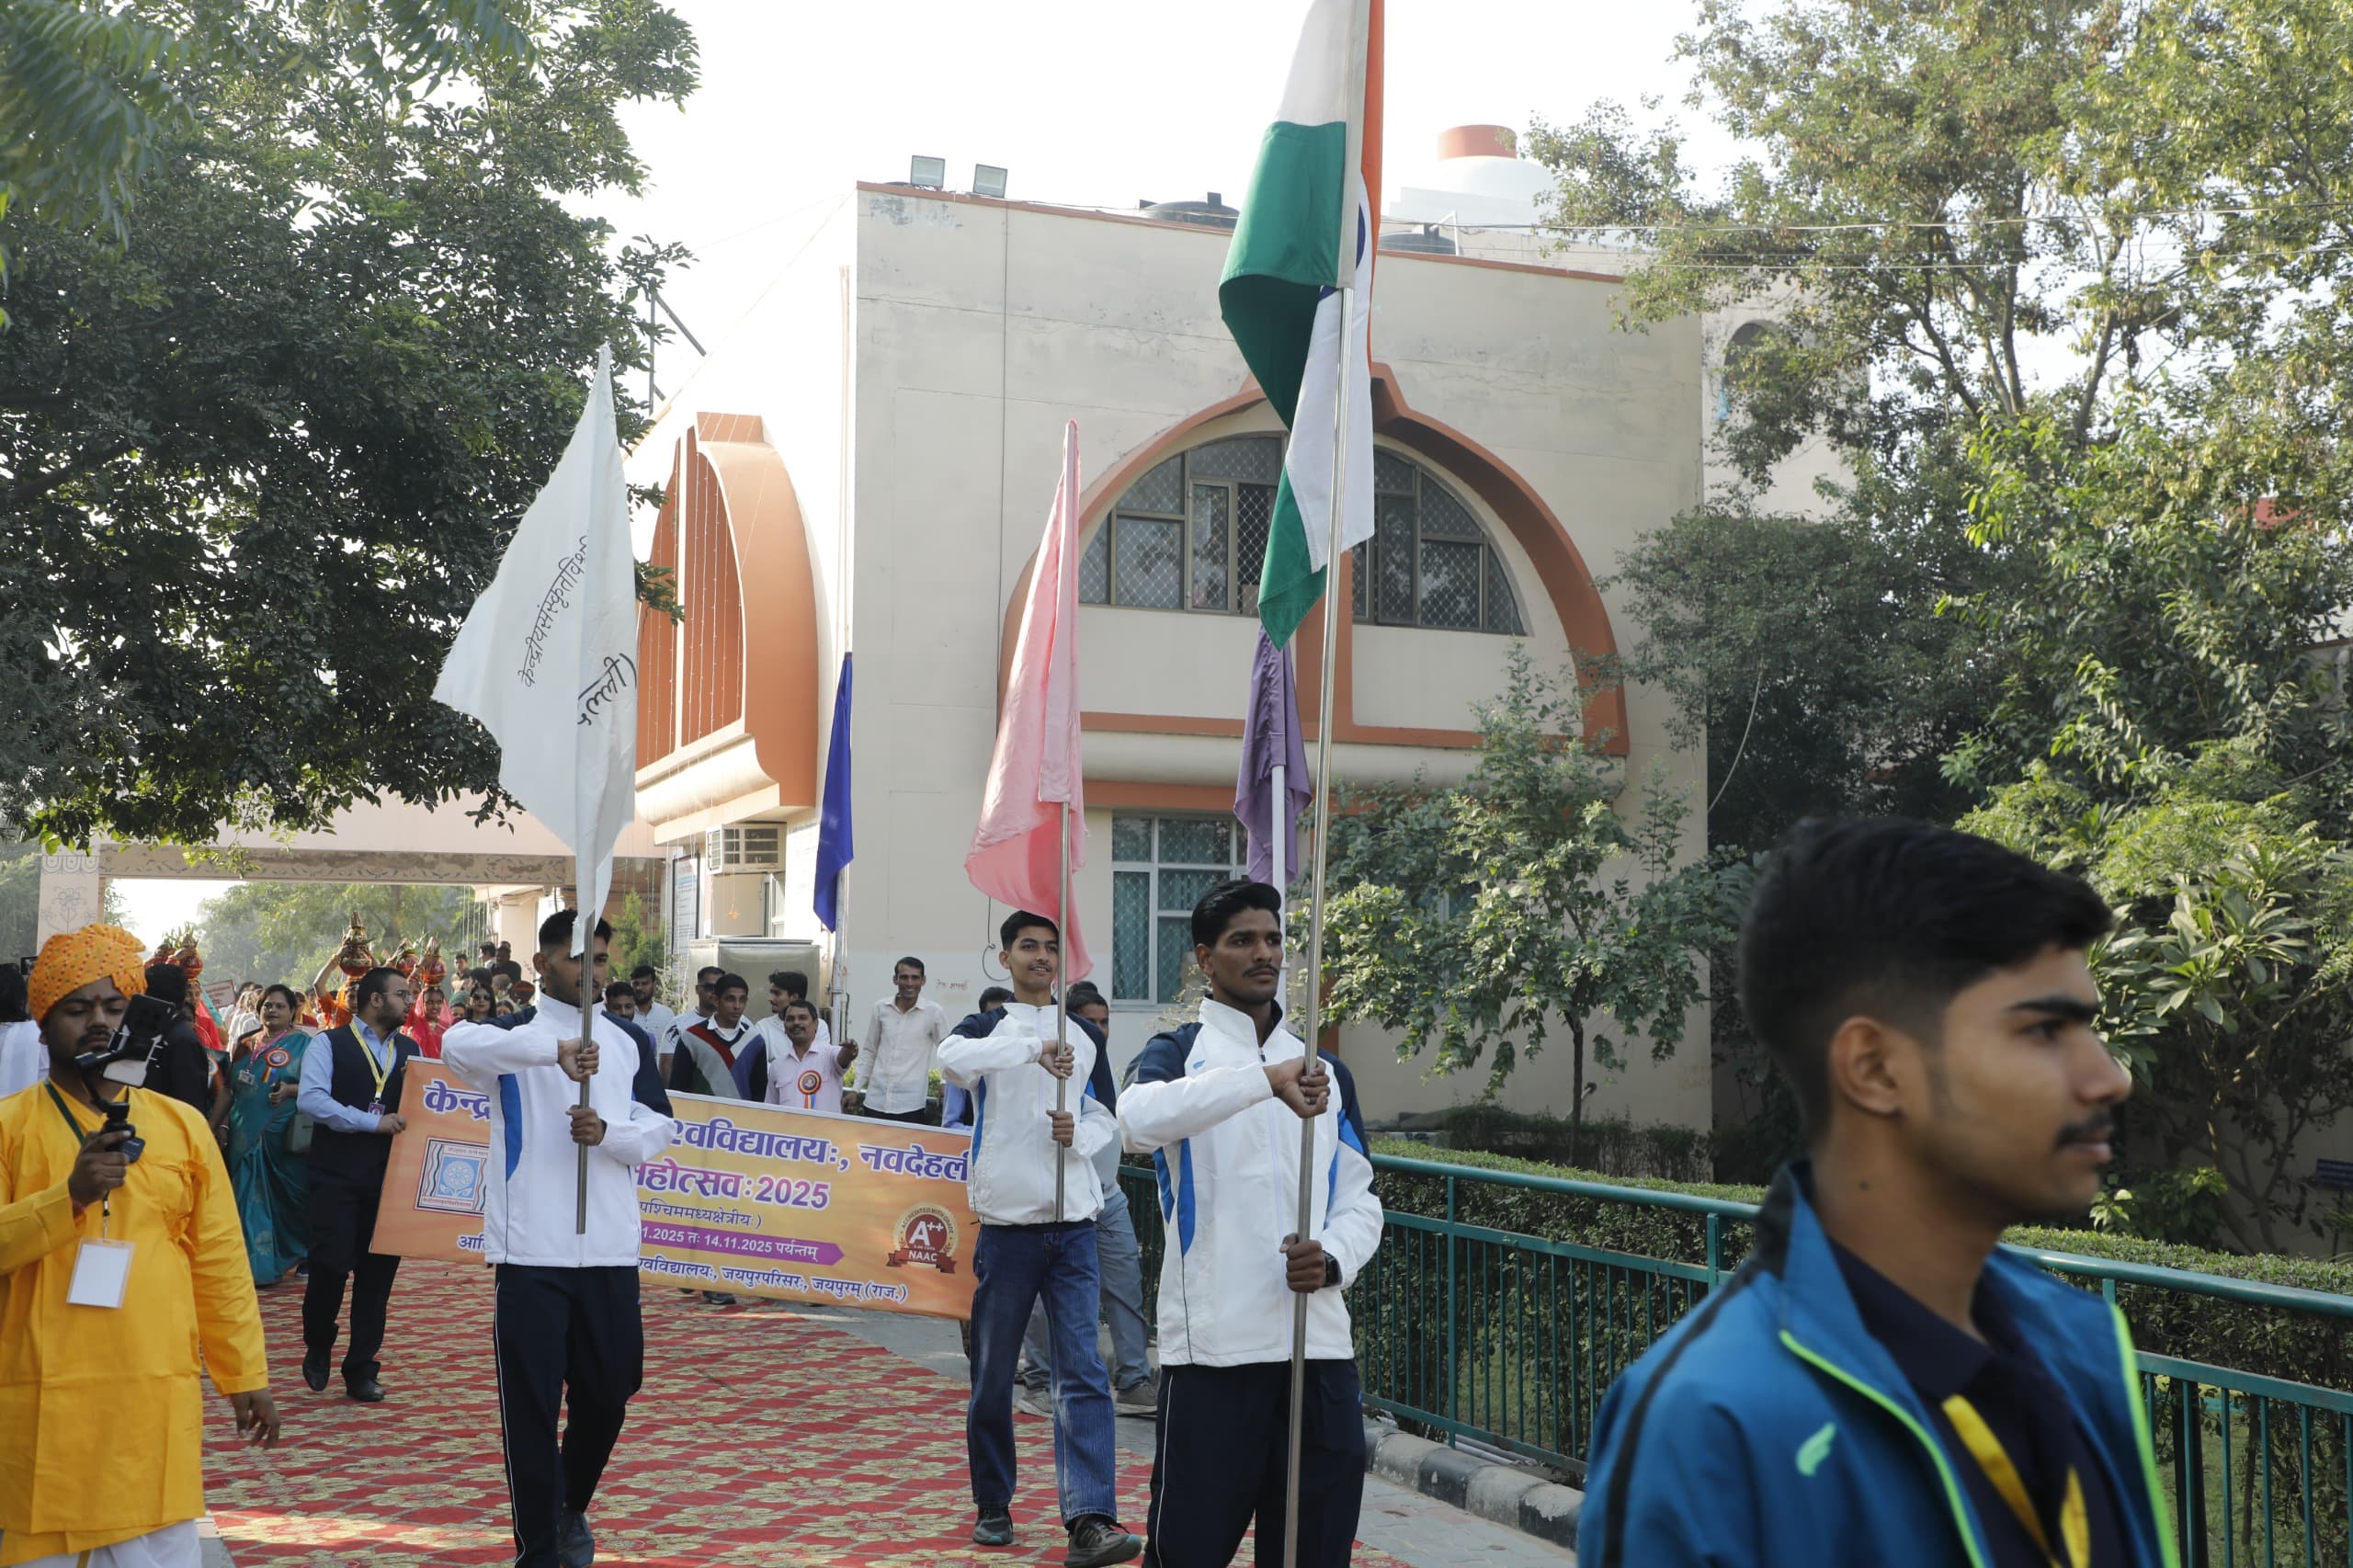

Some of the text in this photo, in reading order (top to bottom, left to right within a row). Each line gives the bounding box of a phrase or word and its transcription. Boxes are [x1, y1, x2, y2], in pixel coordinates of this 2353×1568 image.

[425, 1080, 491, 1119] केन्द्र
[704, 1234, 773, 1253] 14.11.2025
[908, 1221, 944, 1245] A++
[908, 1250, 938, 1262] NAAC
